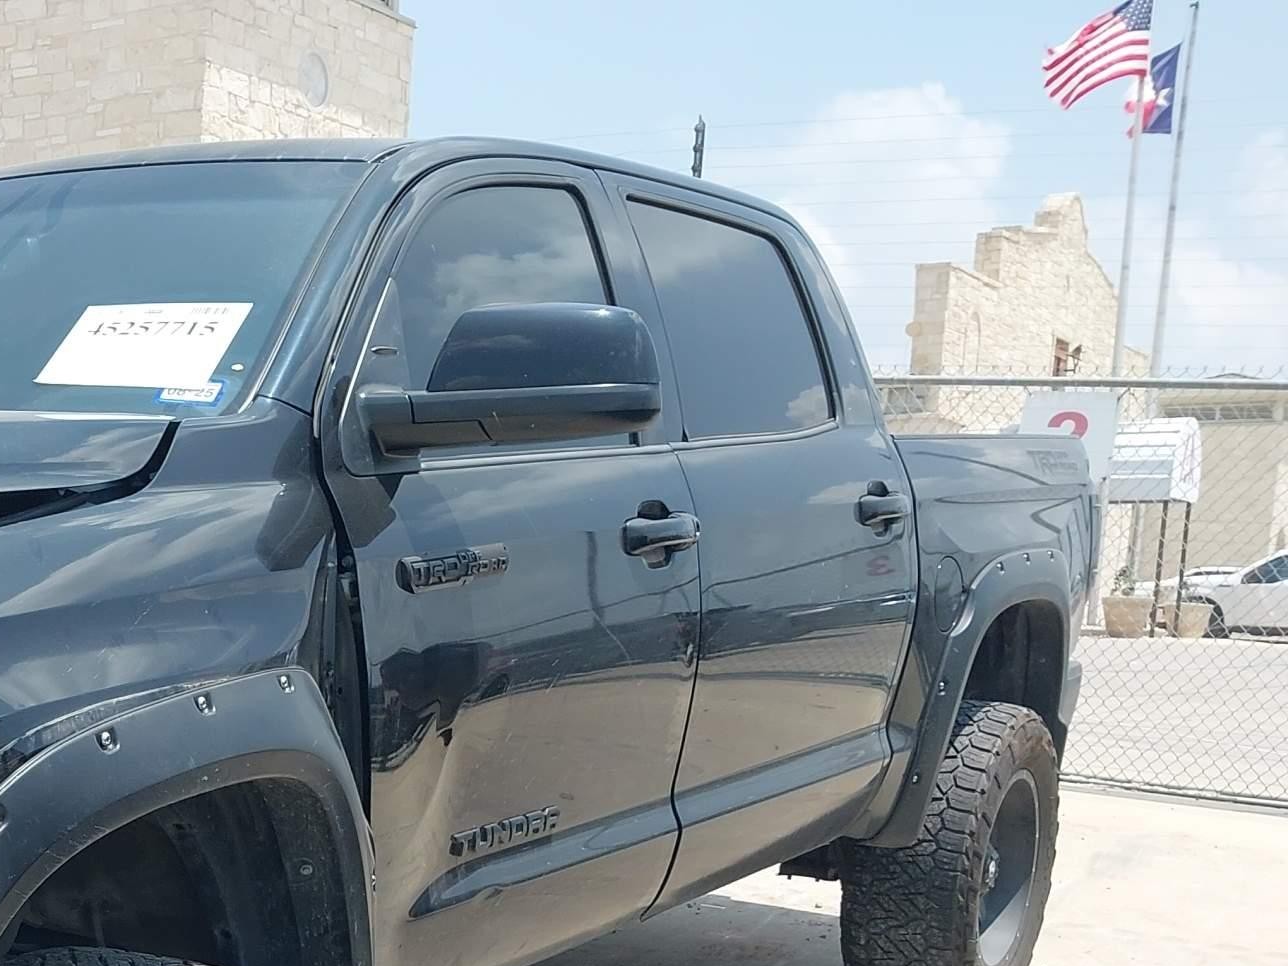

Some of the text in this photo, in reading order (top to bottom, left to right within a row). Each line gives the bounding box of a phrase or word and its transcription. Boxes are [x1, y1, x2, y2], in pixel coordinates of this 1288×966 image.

[88, 320, 220, 337] 45257715
[411, 557, 460, 586] TRD
[449, 804, 561, 857] TUNDRA
